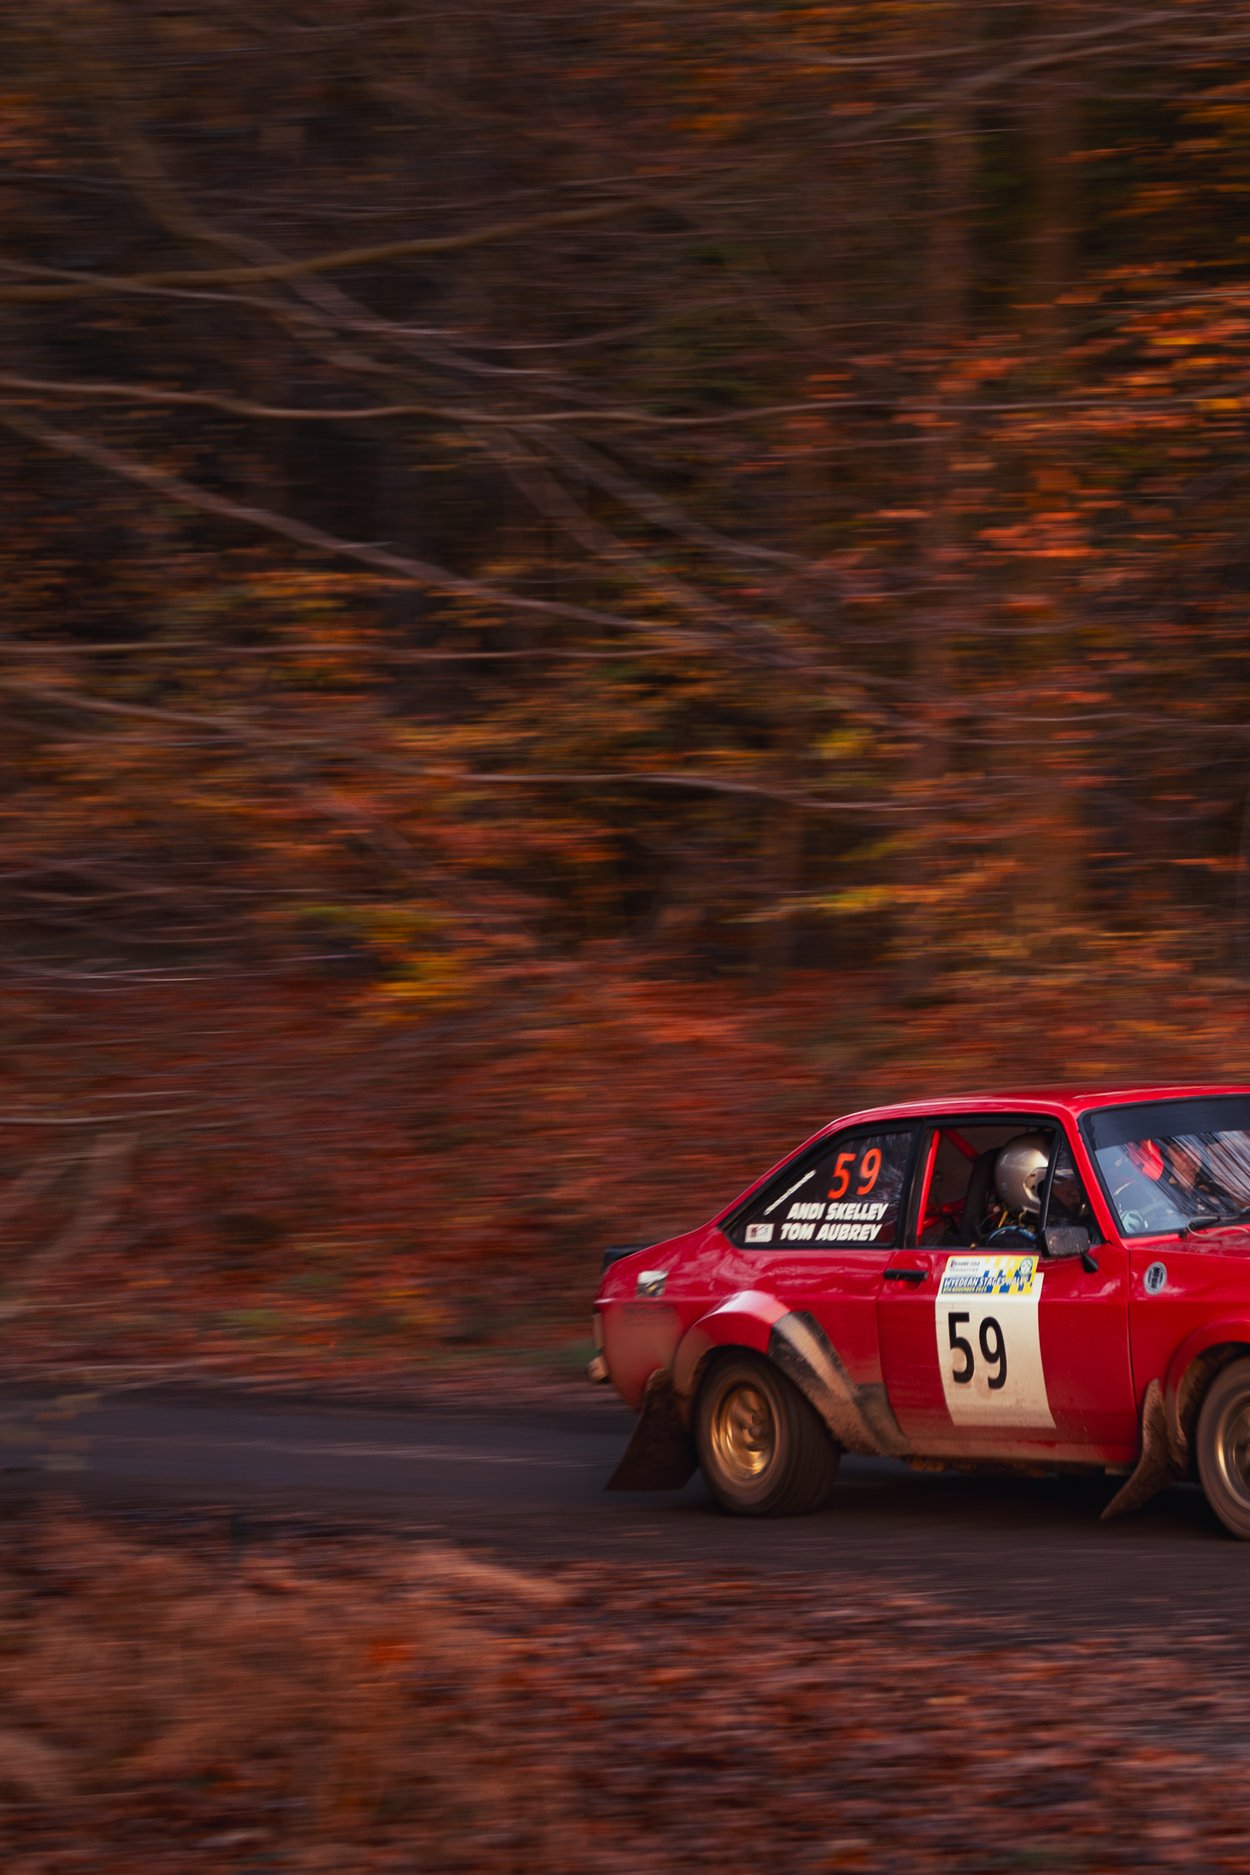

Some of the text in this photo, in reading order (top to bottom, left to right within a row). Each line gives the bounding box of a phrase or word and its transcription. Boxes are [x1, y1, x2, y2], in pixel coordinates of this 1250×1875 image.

[827, 1148, 882, 1199] 59
[786, 1203, 889, 1220] ANDI SKELLEY
[780, 1223, 883, 1241] TOM AUBREY
[948, 1312, 1007, 1389] 59
